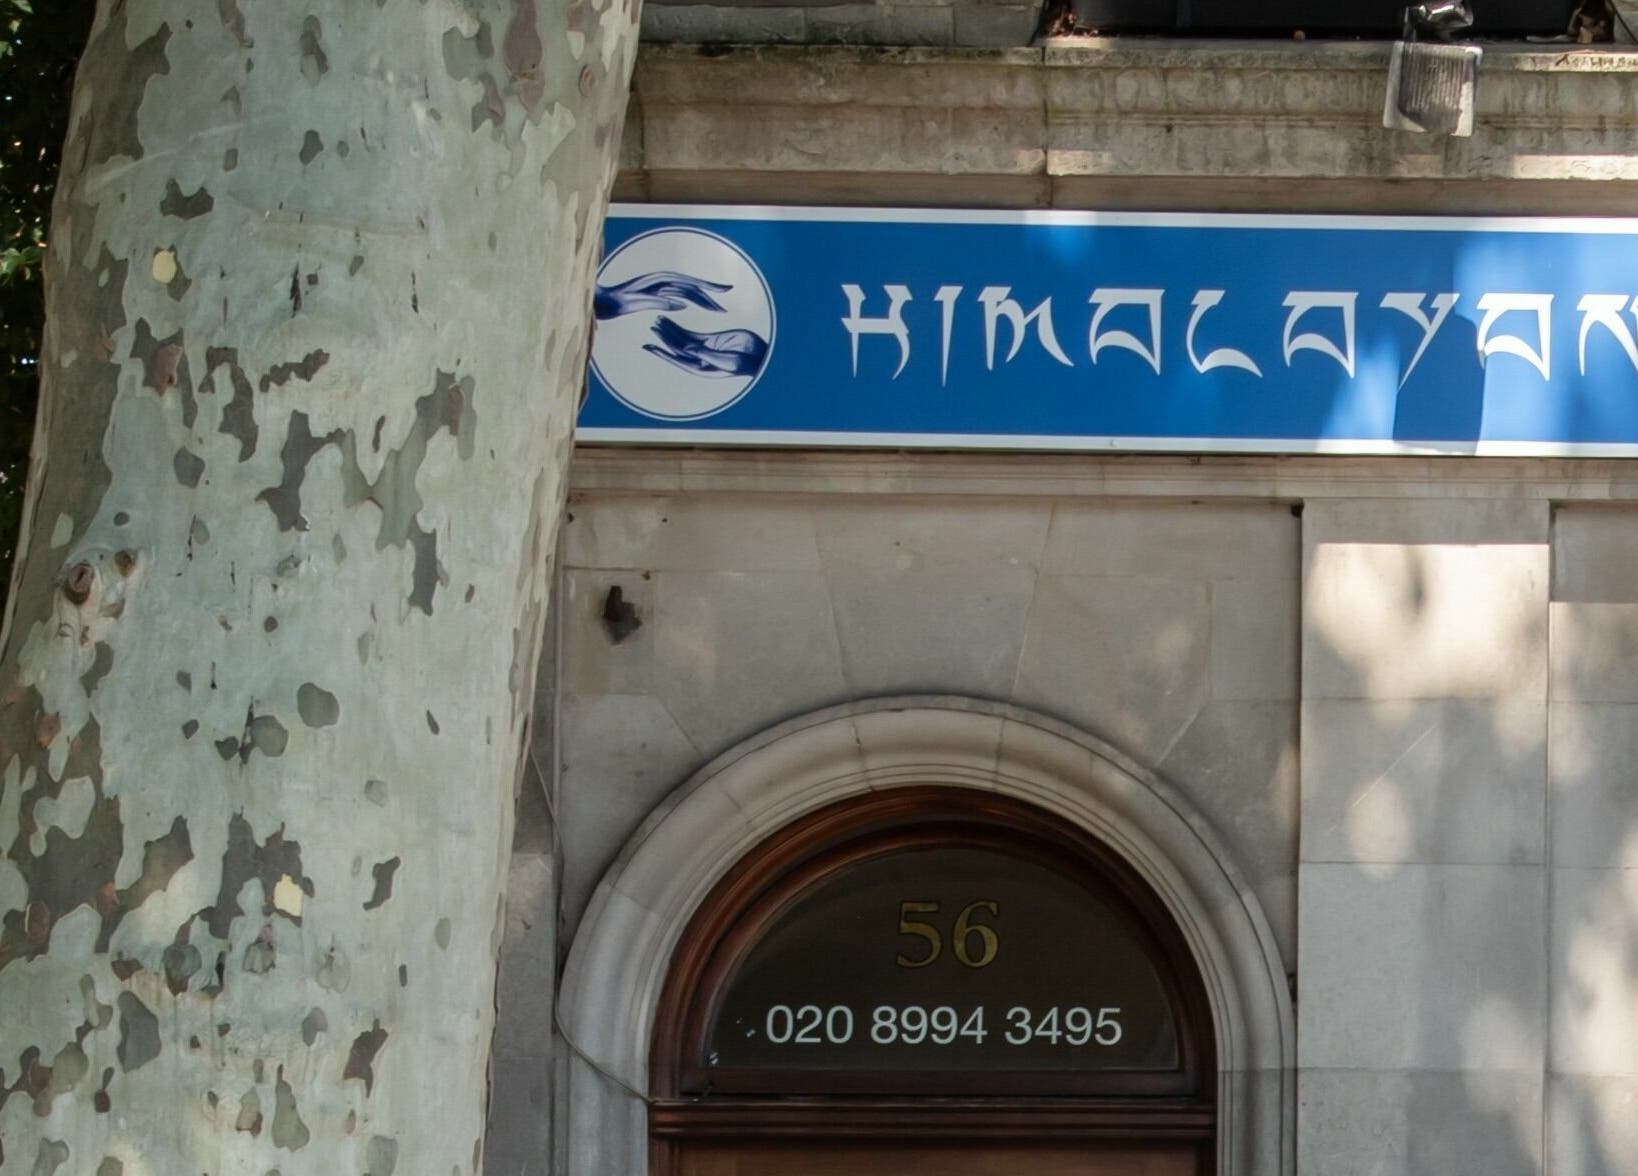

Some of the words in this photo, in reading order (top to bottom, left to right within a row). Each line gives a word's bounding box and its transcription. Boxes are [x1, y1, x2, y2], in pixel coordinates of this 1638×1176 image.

[896, 900, 1000, 968] 56
[765, 1004, 854, 1044] 020
[870, 1006, 988, 1044] 8994
[1004, 1007, 1123, 1046] 3495
